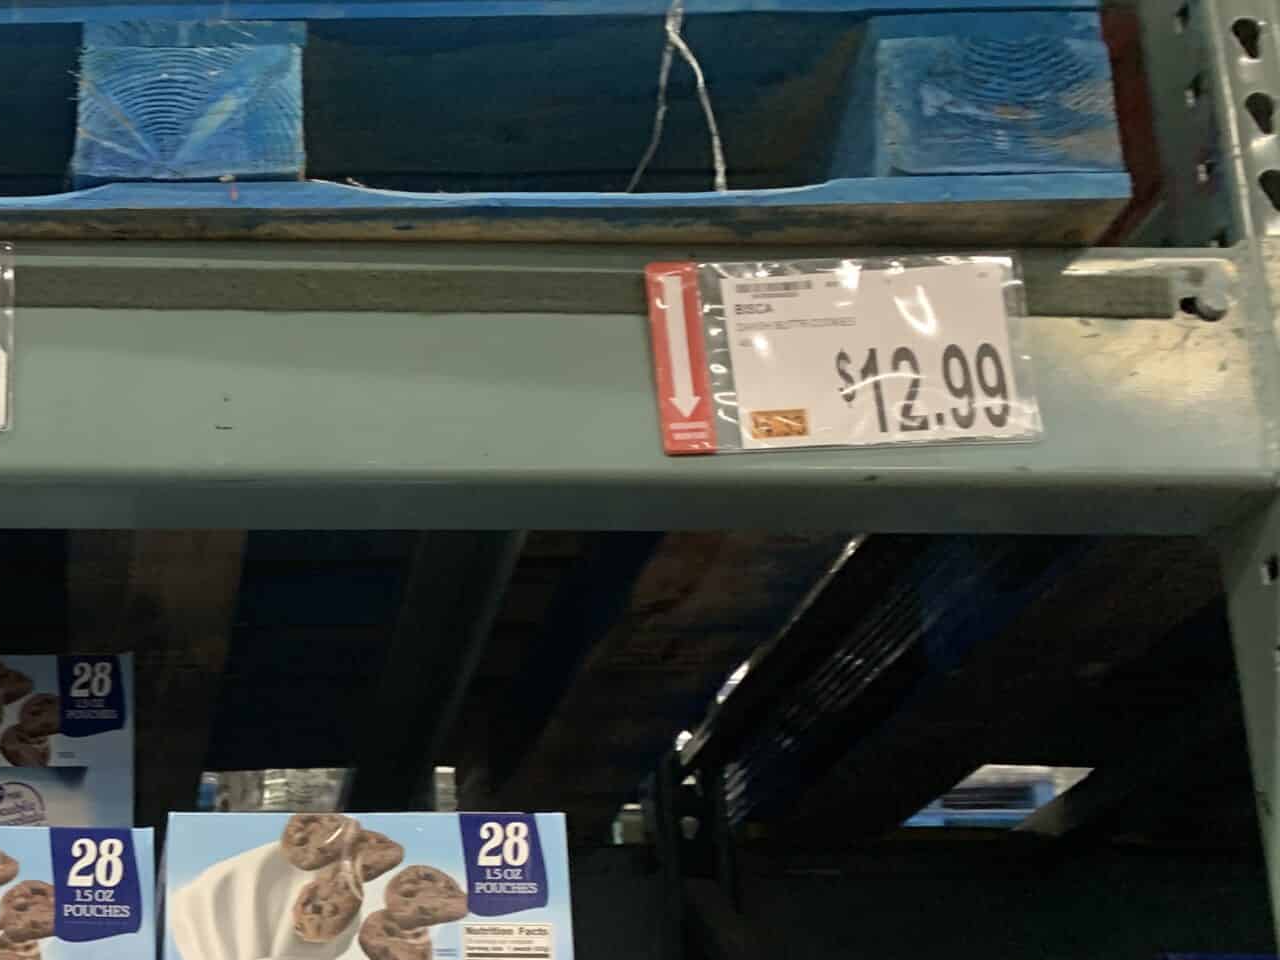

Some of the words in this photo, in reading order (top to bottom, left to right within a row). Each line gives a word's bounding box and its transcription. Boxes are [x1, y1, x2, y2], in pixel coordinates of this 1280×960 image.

[836, 343, 1009, 432] $12.99
[71, 662, 112, 698] 28
[477, 821, 529, 868] 28
[68, 838, 125, 887] 28
[505, 868, 522, 880] OZ
[95, 890, 115, 902] OZ
[475, 882, 538, 895] POUCHES
[63, 903, 131, 918] POUCHES
[519, 927, 549, 936] Facts
